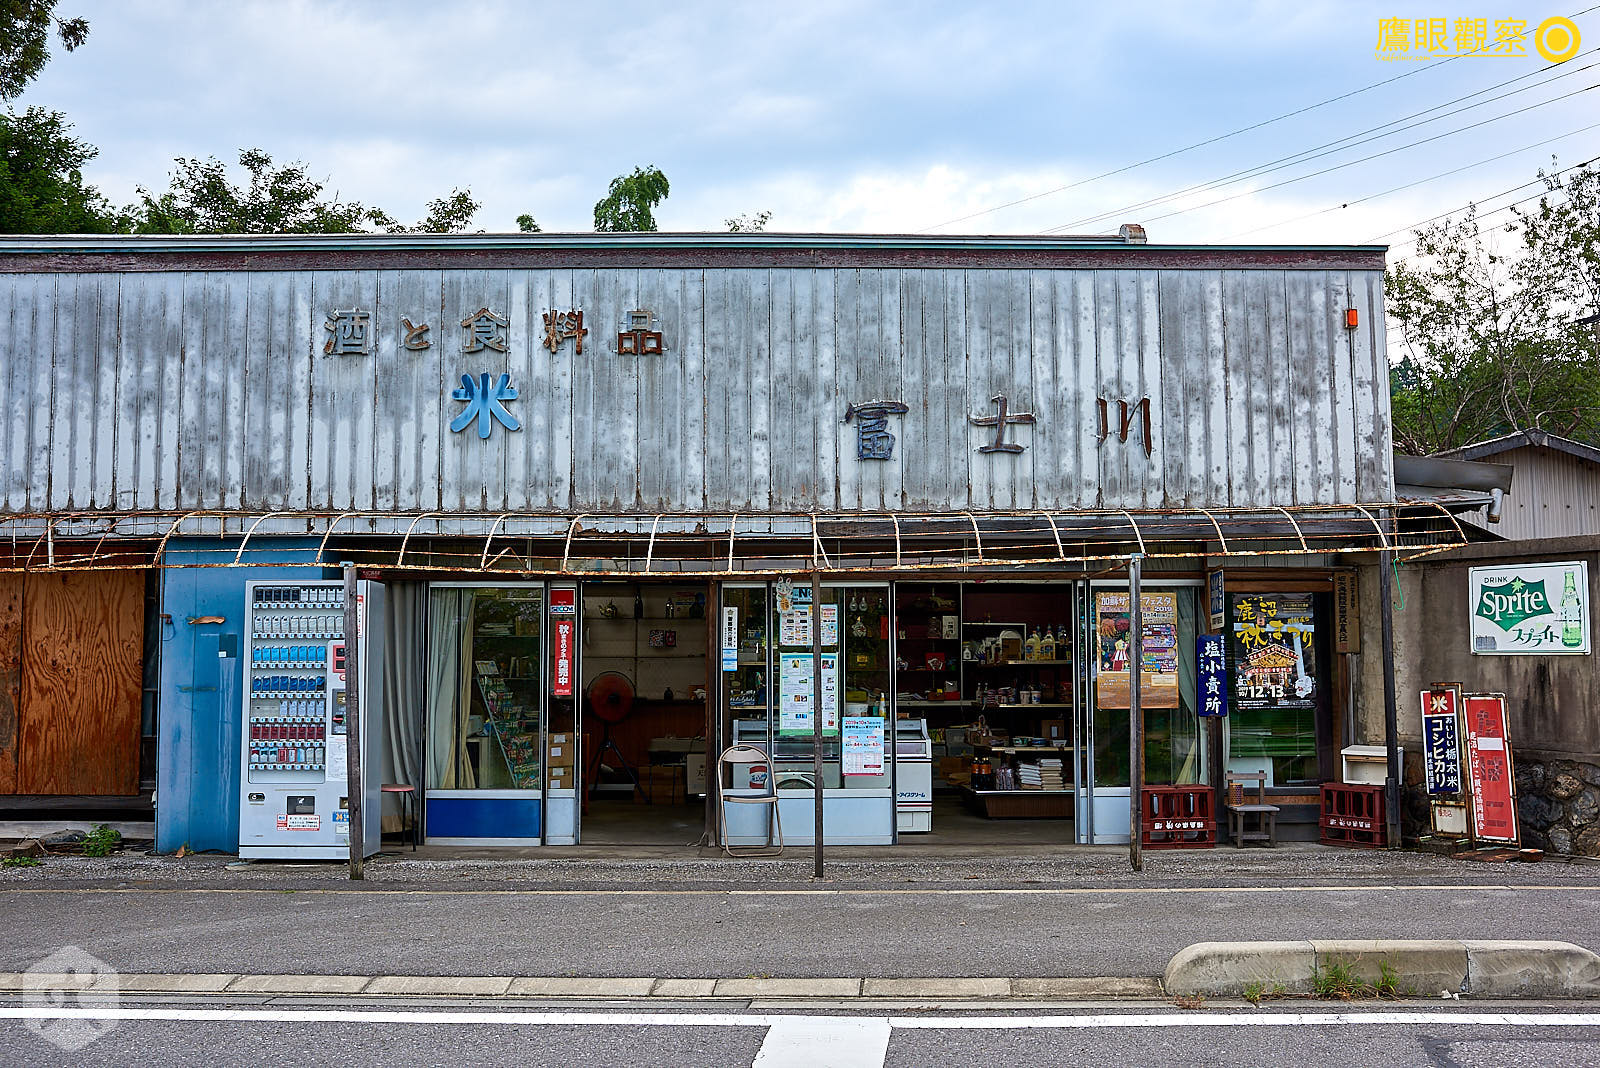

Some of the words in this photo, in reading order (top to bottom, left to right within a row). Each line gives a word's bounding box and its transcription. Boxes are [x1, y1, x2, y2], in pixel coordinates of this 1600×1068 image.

[324, 308, 664, 355] 酒と食料品
[450, 372, 520, 439] 米
[1482, 589, 1545, 621] Sprite
[1509, 624, 1560, 648] スプライト
[1429, 695, 1448, 713] 米
[1431, 719, 1446, 788] コシヒカリ
[1445, 717, 1458, 788] おいしい栃木米
